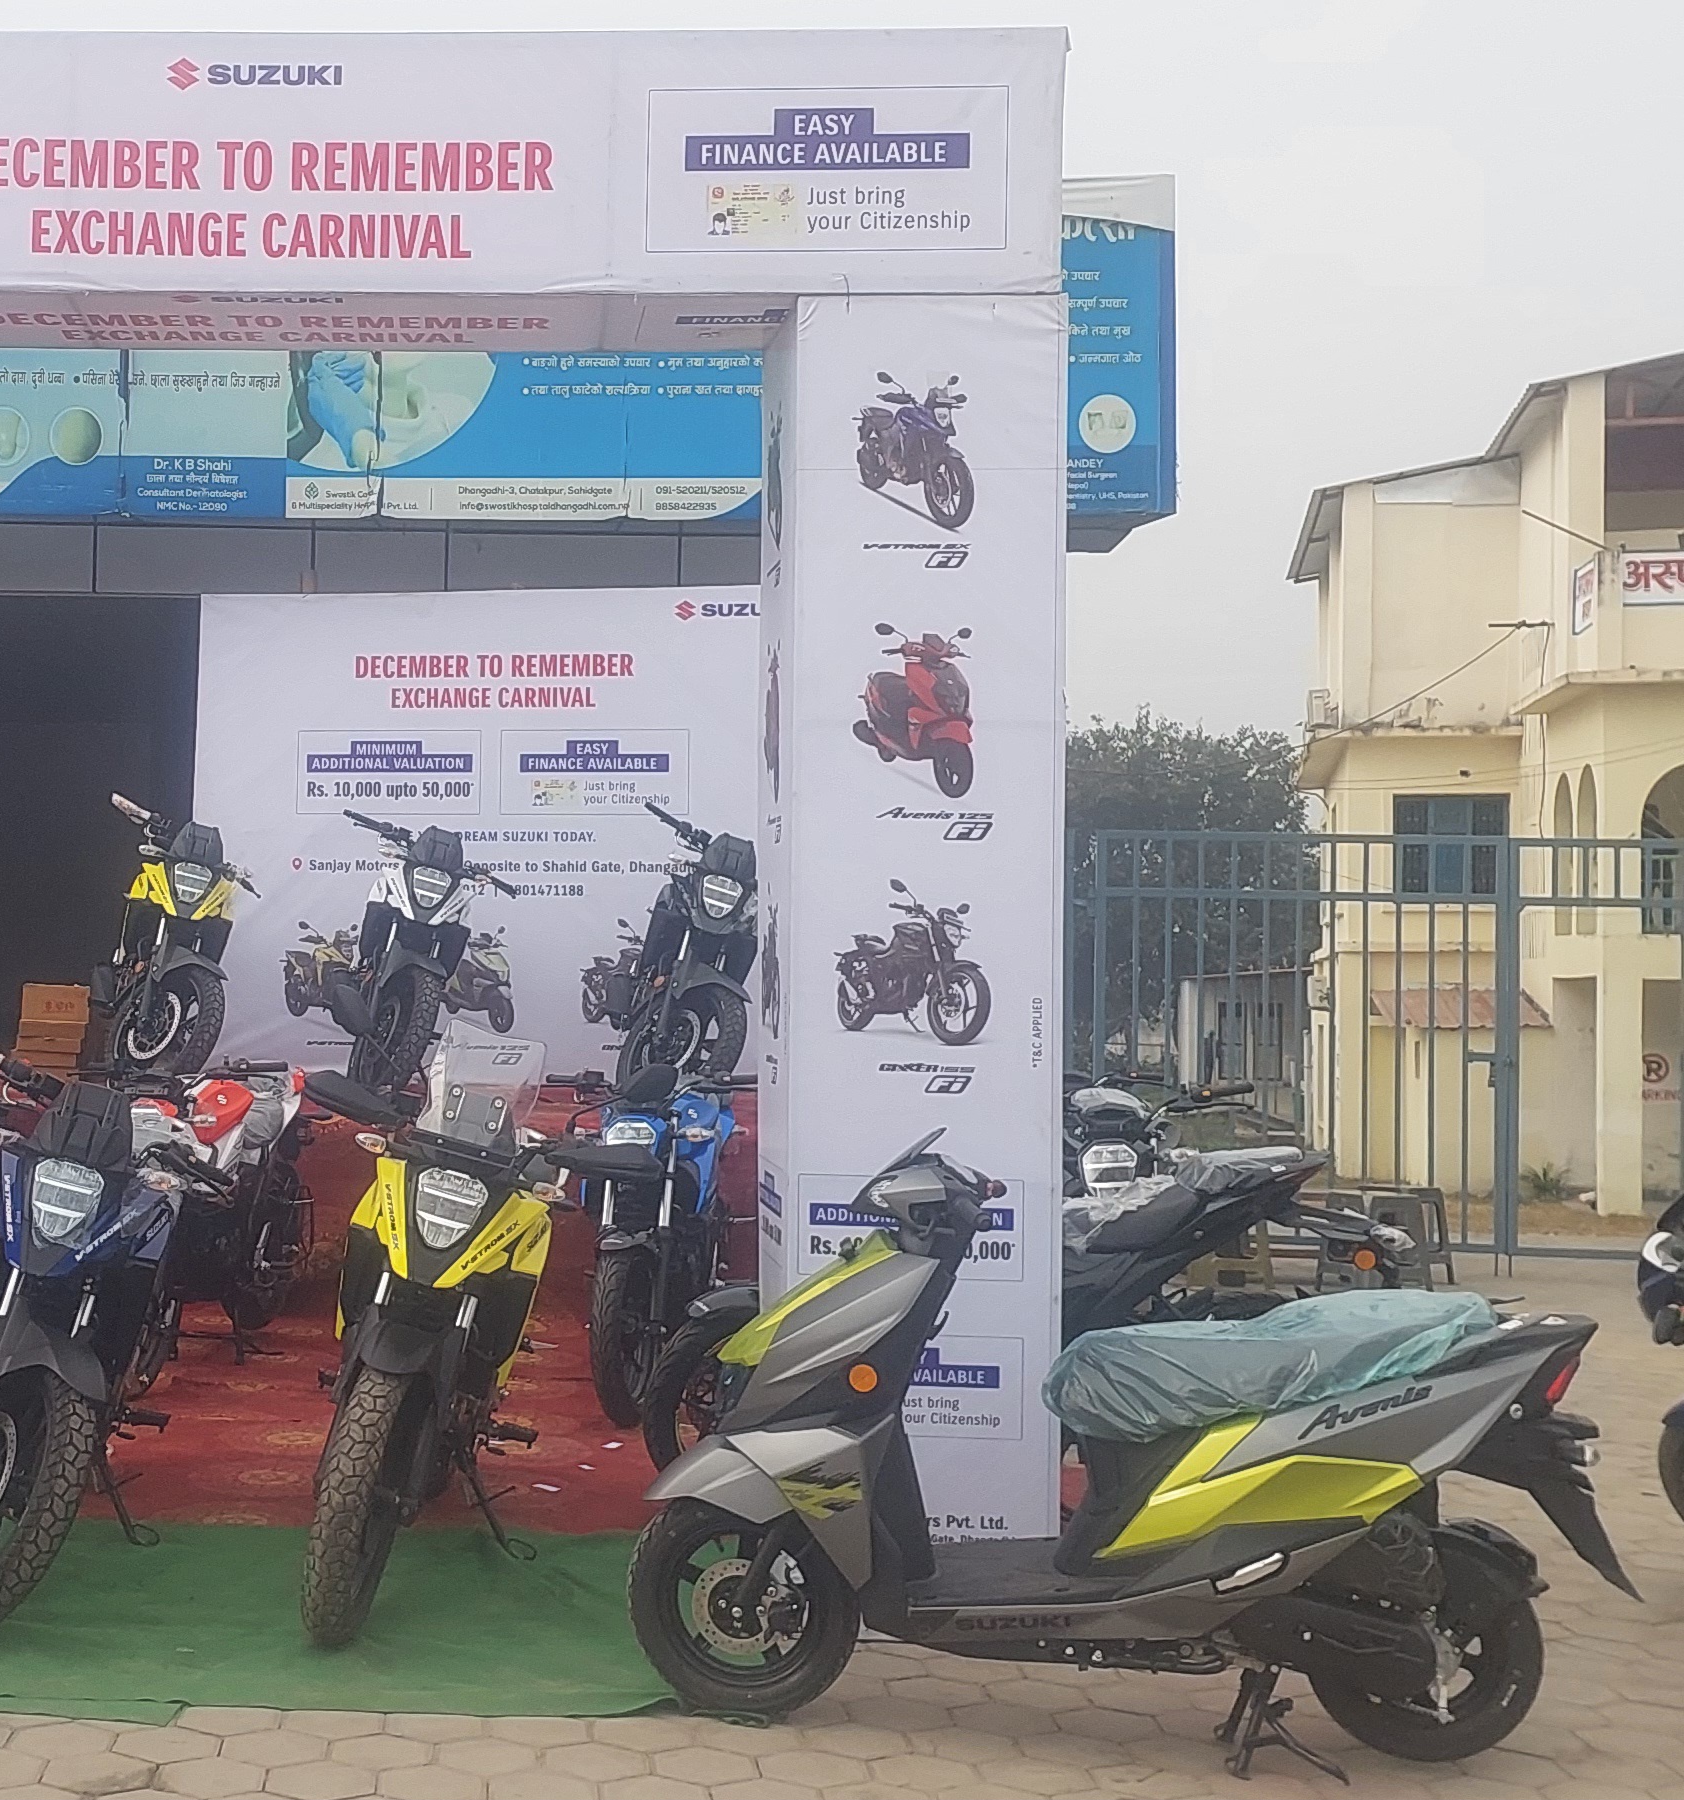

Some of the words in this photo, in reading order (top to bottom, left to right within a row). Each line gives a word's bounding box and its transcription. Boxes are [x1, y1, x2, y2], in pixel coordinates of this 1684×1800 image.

[207, 64, 343, 87] SUZUKI
[793, 113, 855, 136] EASY
[700, 143, 806, 165] FINANCE
[814, 141, 948, 165] AVAILABLE
[217, 140, 273, 192] TO
[291, 140, 555, 192] REMEMBER
[806, 186, 847, 206] Just
[855, 186, 907, 208] bring
[806, 213, 853, 234] your
[859, 210, 972, 233] Citizenship
[31, 209, 247, 258] EXCHANGE
[262, 213, 472, 260] CARNIVAL
[227, 314, 284, 329] TO
[300, 315, 550, 330] REMEMBER
[60, 329, 265, 343] EXCHANGE
[279, 331, 474, 345] CARNIVAL
[1091, 325, 1111, 337] तथा
[211, 374, 228, 388] तथा
[154, 458, 172, 471] Dr.
[174, 458, 184, 470] K
[185, 459, 195, 471] B
[196, 459, 232, 471] Shahi
[137, 487, 185, 498] Consultant
[185, 488, 248, 501] Dermatologist
[325, 489, 356, 499] Swostik
[458, 485, 517, 497] Dhangadhi-3,
[567, 486, 613, 497] Sahidgate
[156, 501, 178, 511] NMC
[198, 502, 228, 512] 12090
[298, 501, 353, 511] Multispeciality
[403, 502, 419, 510] Ltd.
[927, 552, 968, 567] Fi
[354, 654, 470, 679] DECEMBER
[476, 654, 503, 678] TO
[510, 653, 635, 678] REMEMBER
[390, 686, 491, 709] EXCHANGE
[498, 686, 597, 709] CARNIVAL
[355, 743, 418, 757] MINIMUM
[575, 742, 610, 756] EASY
[311, 756, 390, 770] ADDITIONAL
[393, 757, 465, 770] VALUATION
[527, 756, 584, 770] FINANCE
[586, 756, 658, 770] AVAILABLE
[306, 781, 329, 799] Rs.
[333, 781, 383, 801] 10,000
[386, 781, 418, 801] upto
[583, 779, 606, 793] Just
[608, 779, 637, 795] bring
[583, 794, 608, 807] your
[611, 792, 670, 807] Citizenship
[876, 806, 954, 820] Avenis
[958, 812, 995, 820] 125
[502, 831, 549, 842] SUZUKI
[552, 831, 597, 843] TODAY.
[945, 822, 992, 839] Fi
[308, 859, 352, 873] Sanjay
[355, 859, 400, 872] Motors
[525, 861, 538, 873] to
[542, 860, 587, 873] Shahid
[591, 861, 625, 875] Gate,
[511, 885, 584, 897] 801471188
[1032, 997, 1043, 1034] APPLIED
[927, 1076, 971, 1093] Fi
[74, 1220, 122, 1262] V-STROM
[390, 1232, 400, 1251] SX
[460, 1232, 506, 1272] V-STROM
[505, 1219, 521, 1236] SX
[809, 1235, 838, 1256] Rs.
[927, 1396, 961, 1411] bring
[930, 1412, 1001, 1428] Citizenship
[1297, 1384, 1433, 1440] Avenis
[946, 1513, 975, 1529] Pvt.
[979, 1514, 1009, 1530] Ltd.
[954, 1614, 1072, 1632] SUZUKI
